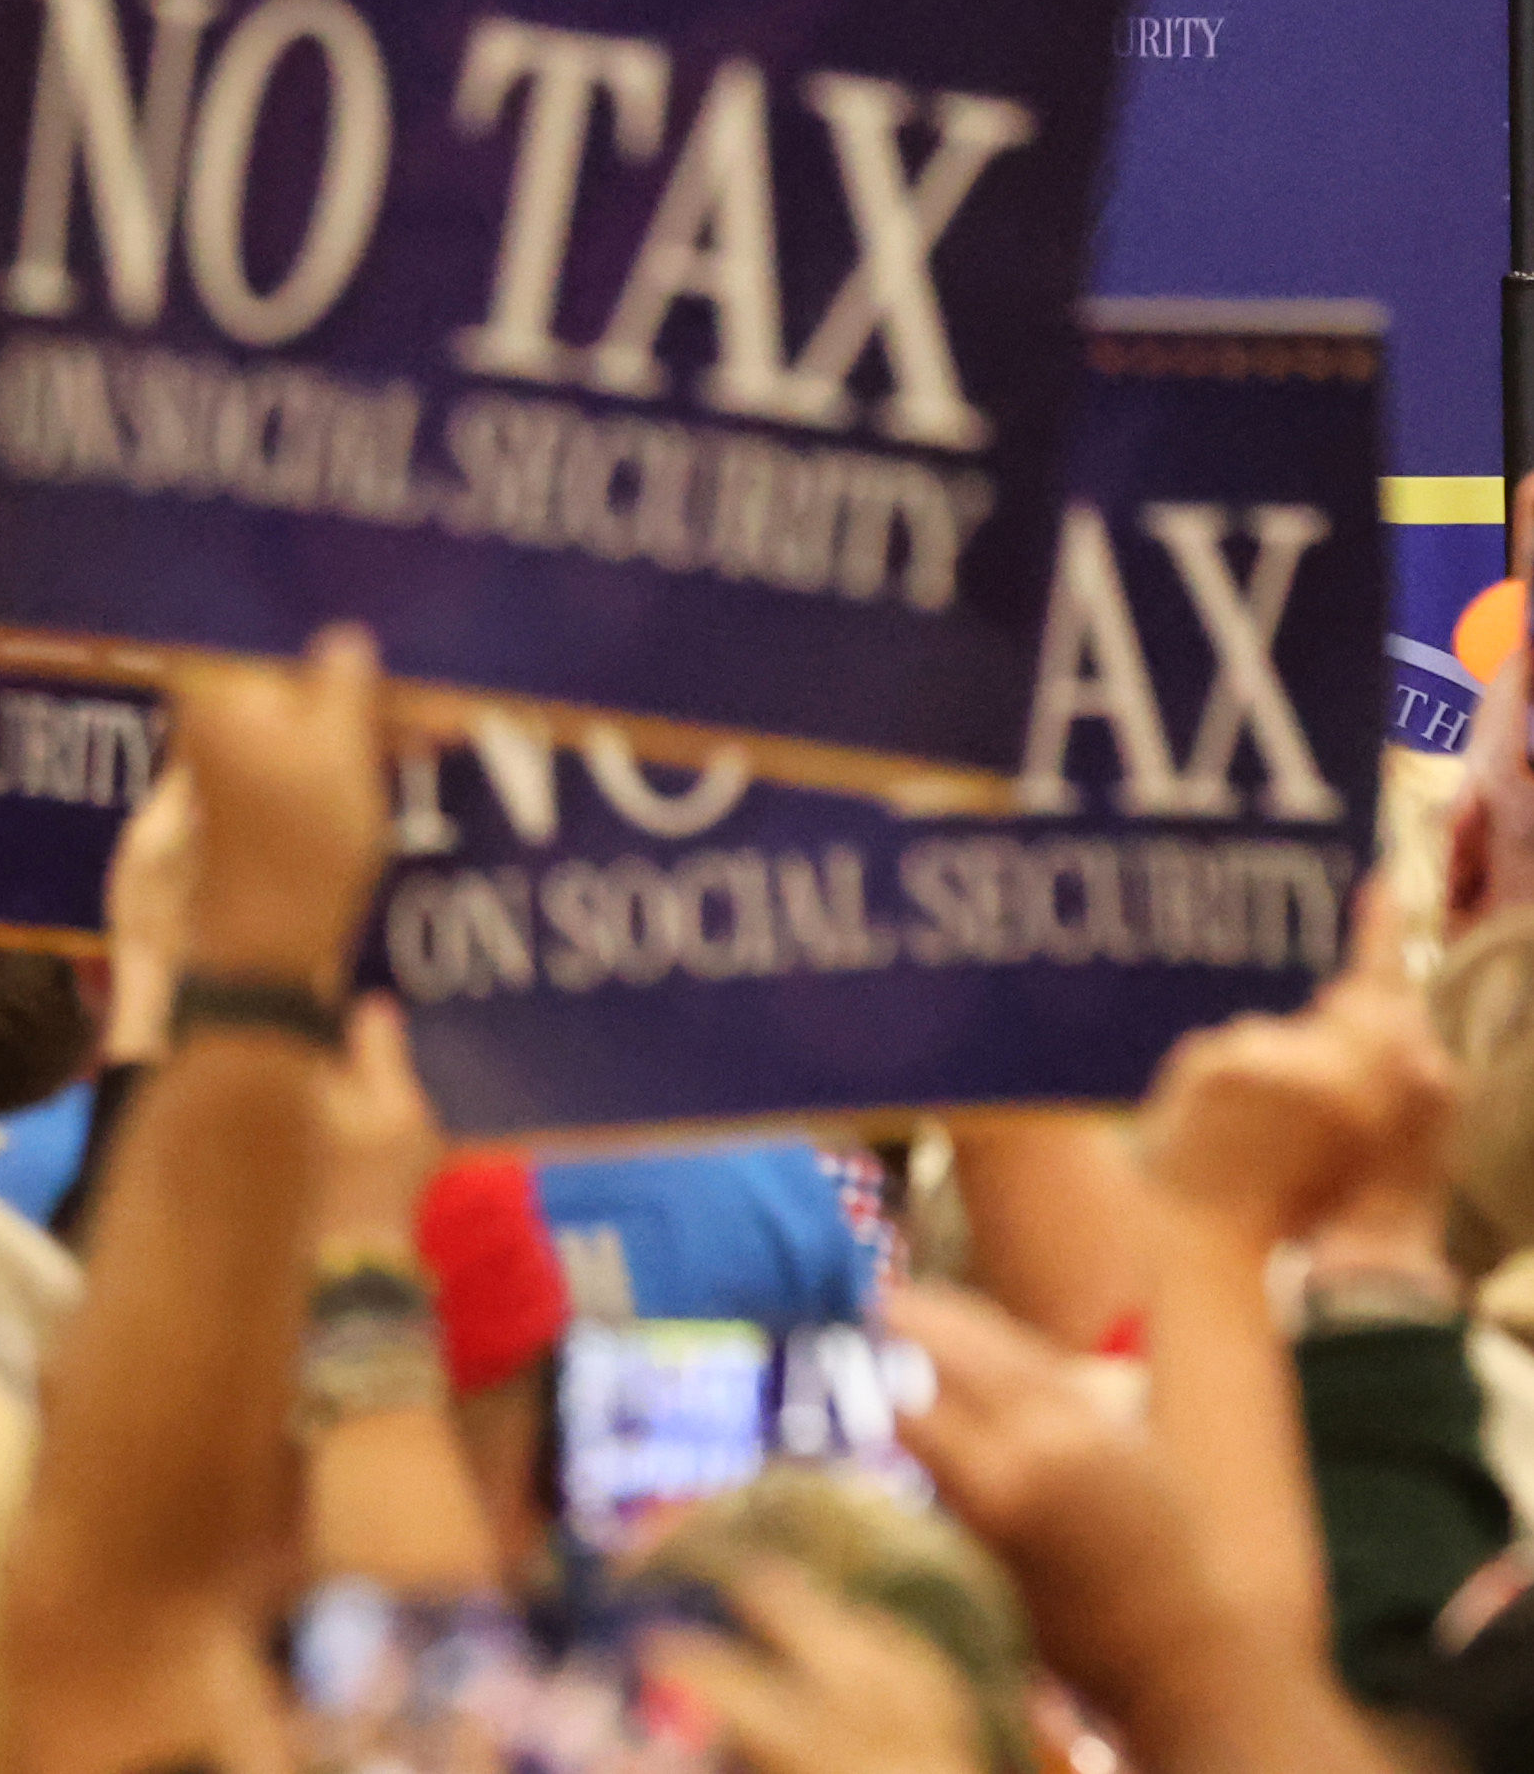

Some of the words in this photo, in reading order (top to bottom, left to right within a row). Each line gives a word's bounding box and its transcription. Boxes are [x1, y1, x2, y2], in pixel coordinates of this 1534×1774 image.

[447, 16, 1037, 450] TAX
[1012, 503, 1344, 818] AX
[1397, 684, 1471, 753] TH
